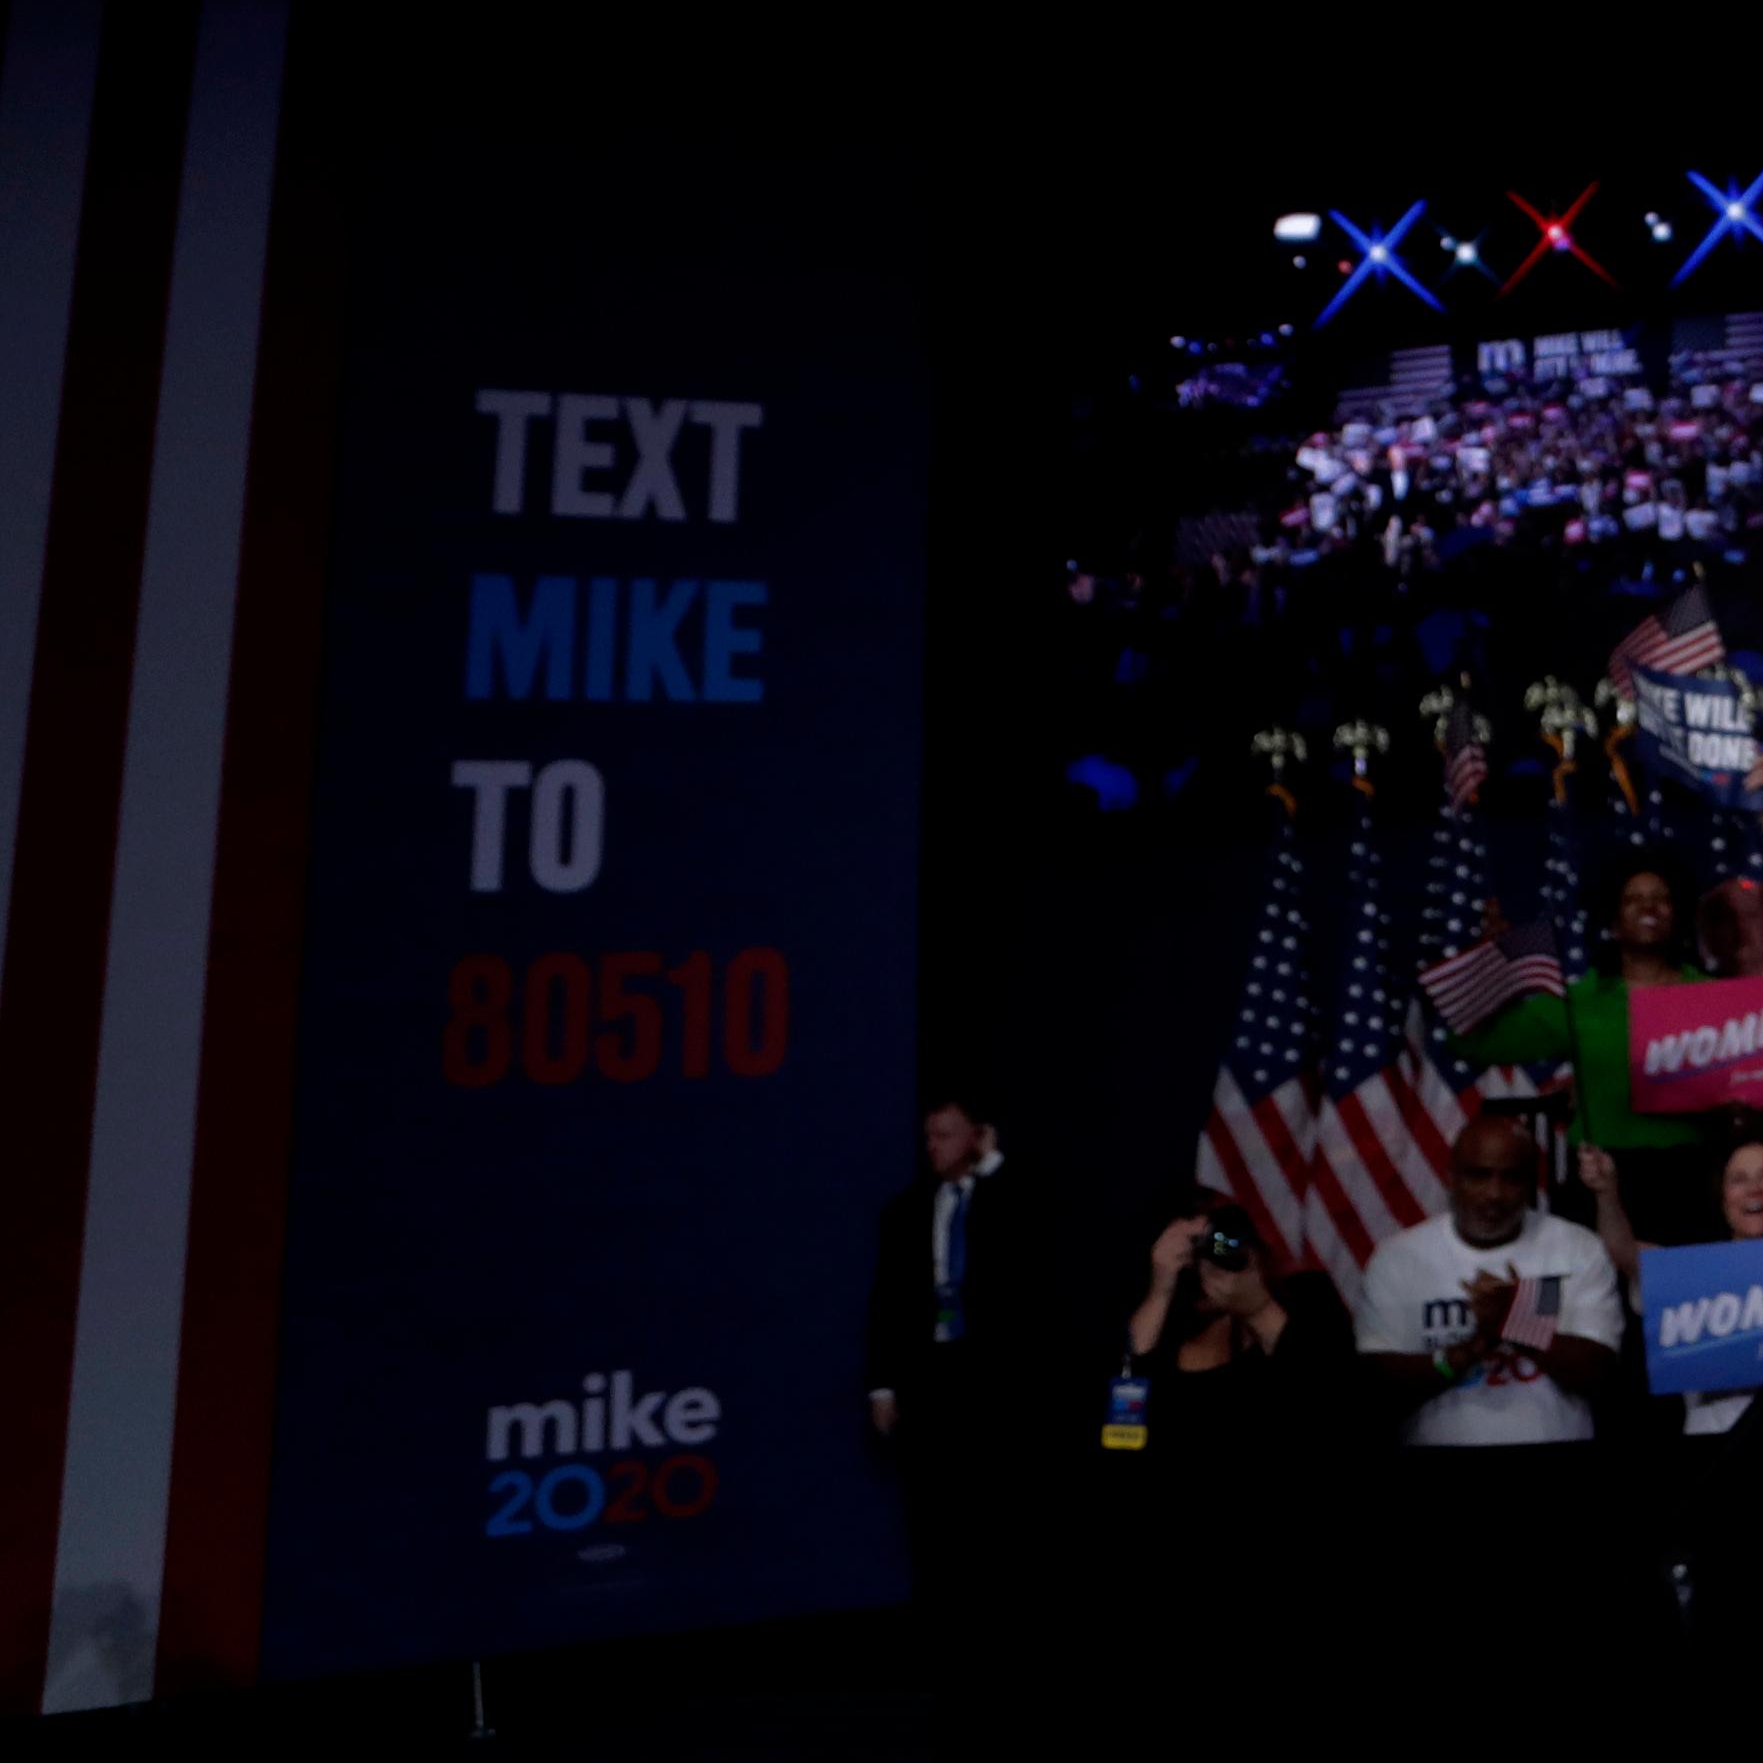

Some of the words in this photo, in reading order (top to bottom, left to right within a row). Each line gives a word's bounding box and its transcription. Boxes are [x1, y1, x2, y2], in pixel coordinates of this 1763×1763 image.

[474, 387, 765, 525] TEXT
[463, 572, 769, 704] MIKE
[450, 758, 605, 894] TO
[440, 947, 790, 1089] 80510
[485, 1368, 723, 1463] mike
[484, 1453, 718, 1538] 2020
